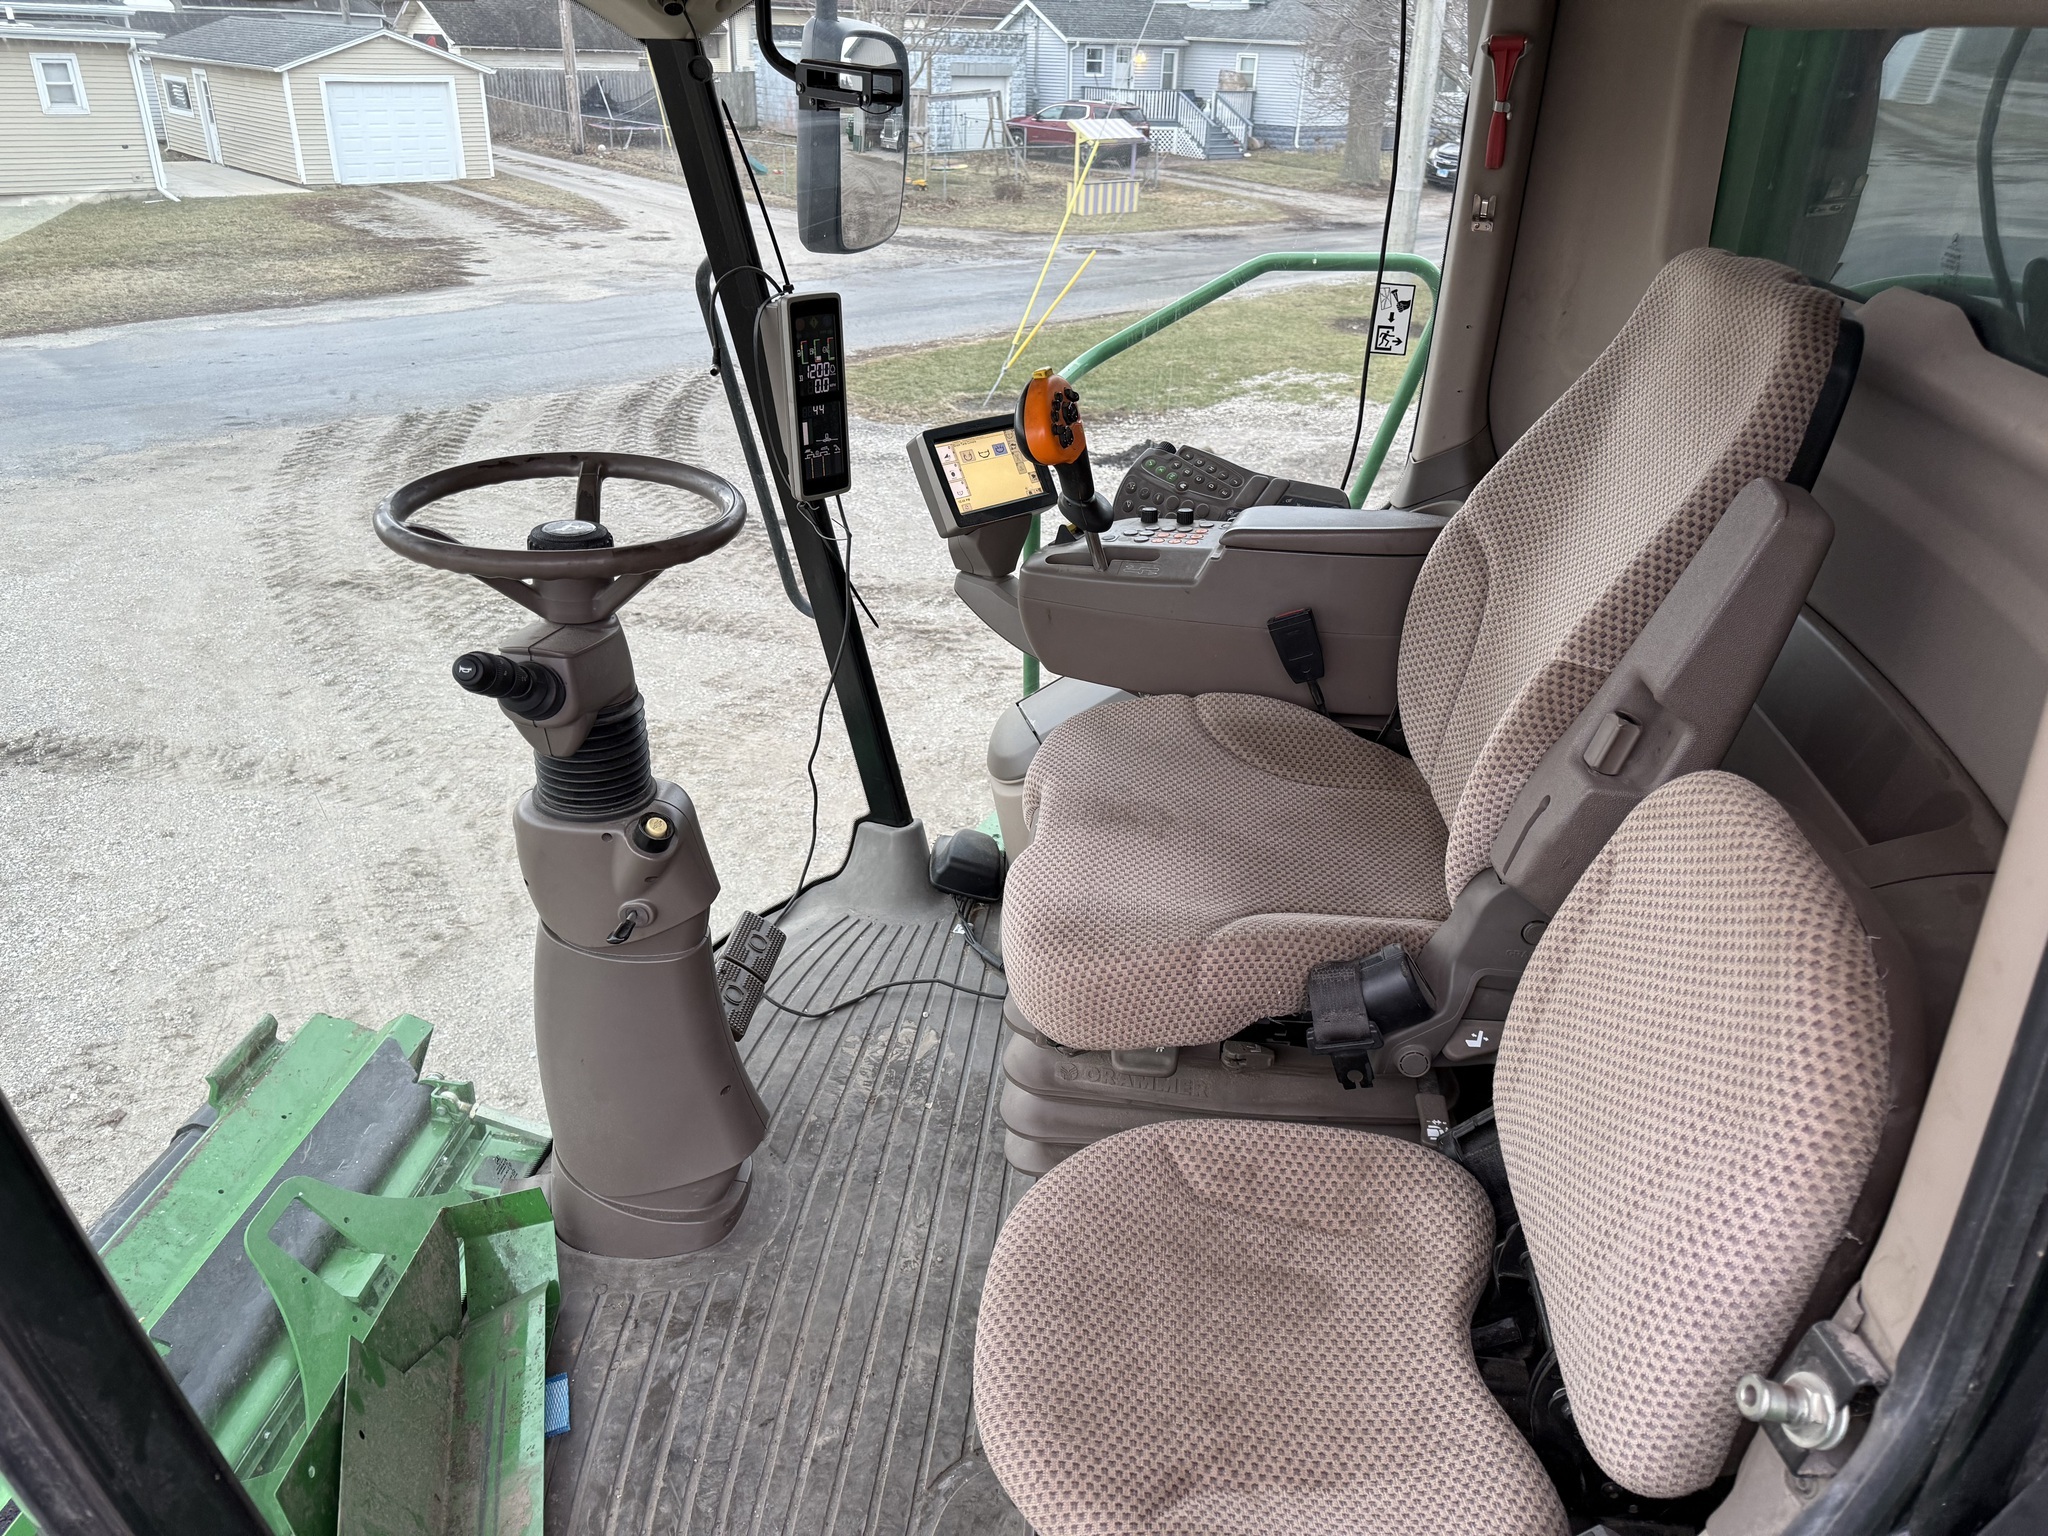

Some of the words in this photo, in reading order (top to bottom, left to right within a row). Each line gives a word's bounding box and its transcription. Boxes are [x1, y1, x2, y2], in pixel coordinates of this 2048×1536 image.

[807, 362, 830, 379] 1200
[815, 378, 830, 394] 0.0
[813, 404, 825, 415] 44
